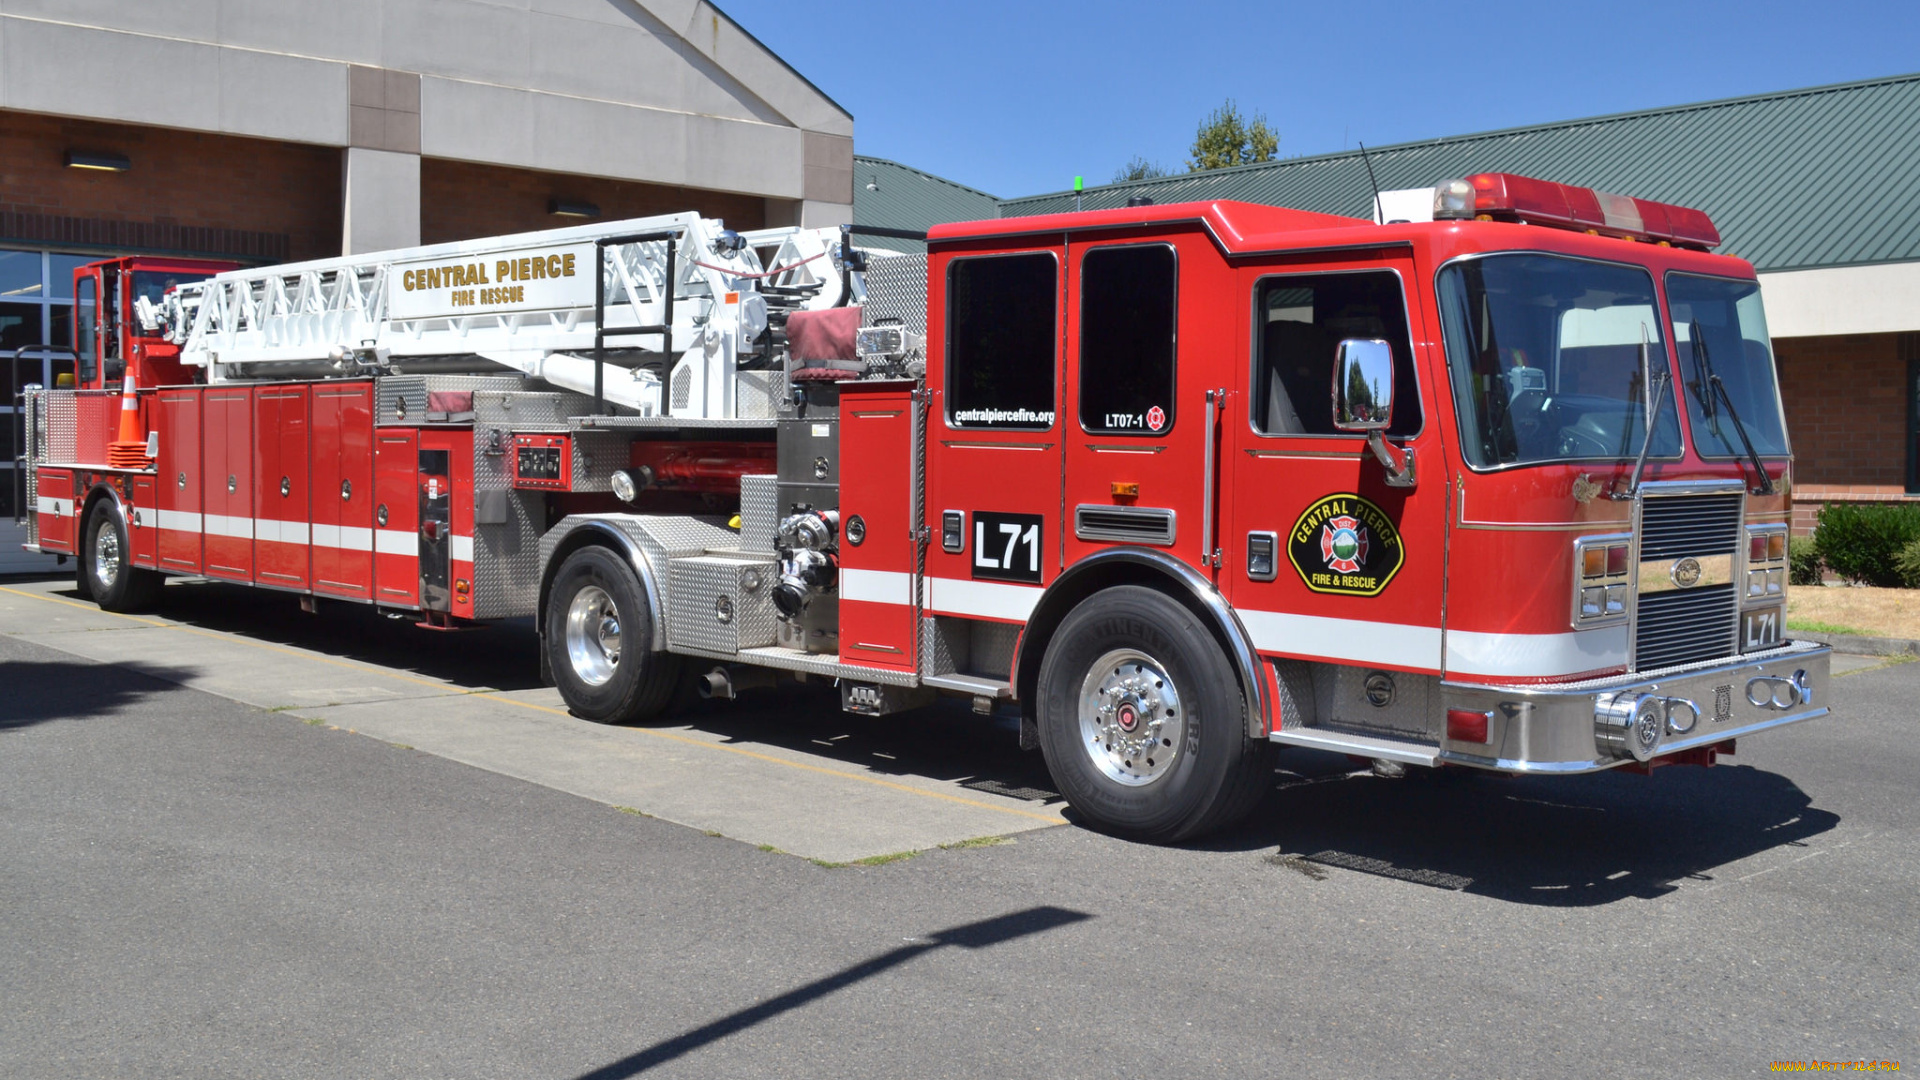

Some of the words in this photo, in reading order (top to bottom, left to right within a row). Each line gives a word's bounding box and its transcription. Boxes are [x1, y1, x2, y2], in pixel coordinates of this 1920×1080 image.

[403, 262, 489, 292] CENTRAL
[496, 253, 576, 283] PIERCE
[452, 289, 475, 307] FIRE
[480, 285, 525, 305] RESCUE
[955, 406, 1055, 425] centralpiercefire.org
[1105, 414, 1143, 428] LT07-1
[1296, 500, 1349, 544] CENTRAL
[1354, 503, 1396, 549] PIERCE
[975, 521, 1039, 572] L71
[1312, 573, 1331, 586] FIRE
[1333, 574, 1341, 586] &
[1342, 575, 1377, 589] RESCUE
[1747, 612, 1776, 647] L71
